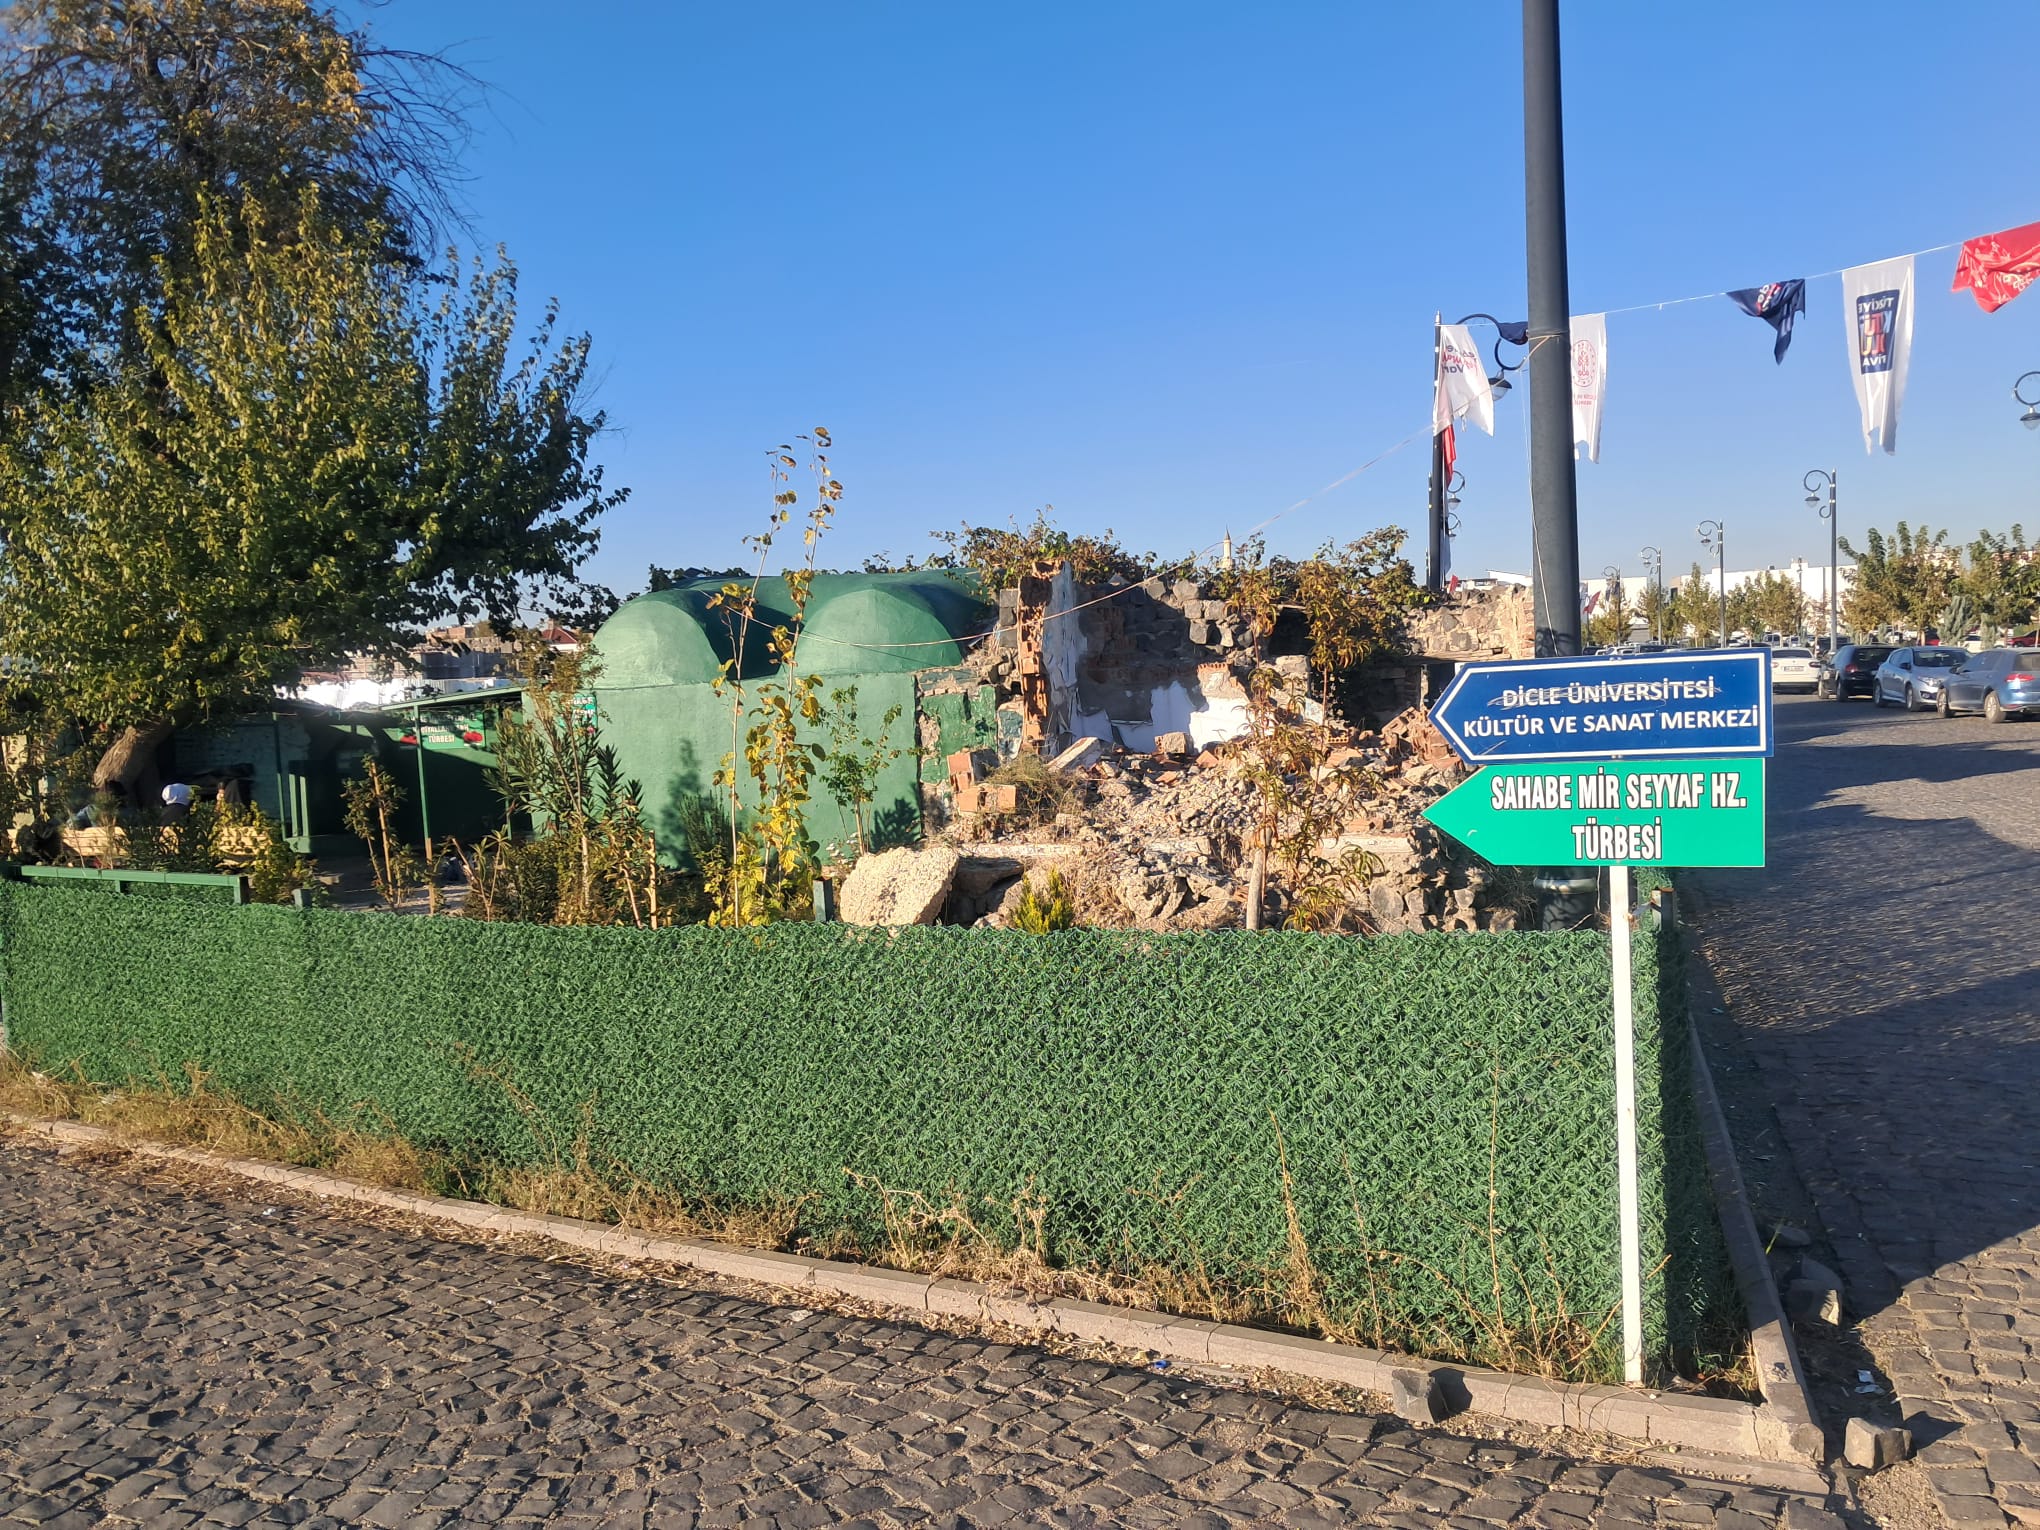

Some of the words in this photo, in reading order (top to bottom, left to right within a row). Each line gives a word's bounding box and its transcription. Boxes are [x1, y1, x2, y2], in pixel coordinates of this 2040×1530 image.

[1503, 684, 1560, 708] DİCLE
[1567, 676, 1714, 704] ÜNİVERSİTESİ
[1464, 716, 1544, 738] KÜLTÜR
[1550, 716, 1577, 734] VE
[1583, 714, 1654, 733] SANAT
[1660, 704, 1758, 728] MERKEZİ
[1491, 775, 1571, 810] SAHABE
[1578, 766, 1620, 809] MİR
[1626, 773, 1704, 809] SEYYAF
[1711, 773, 1747, 808] HZ.
[1572, 816, 1661, 860] TÜRBESİ
